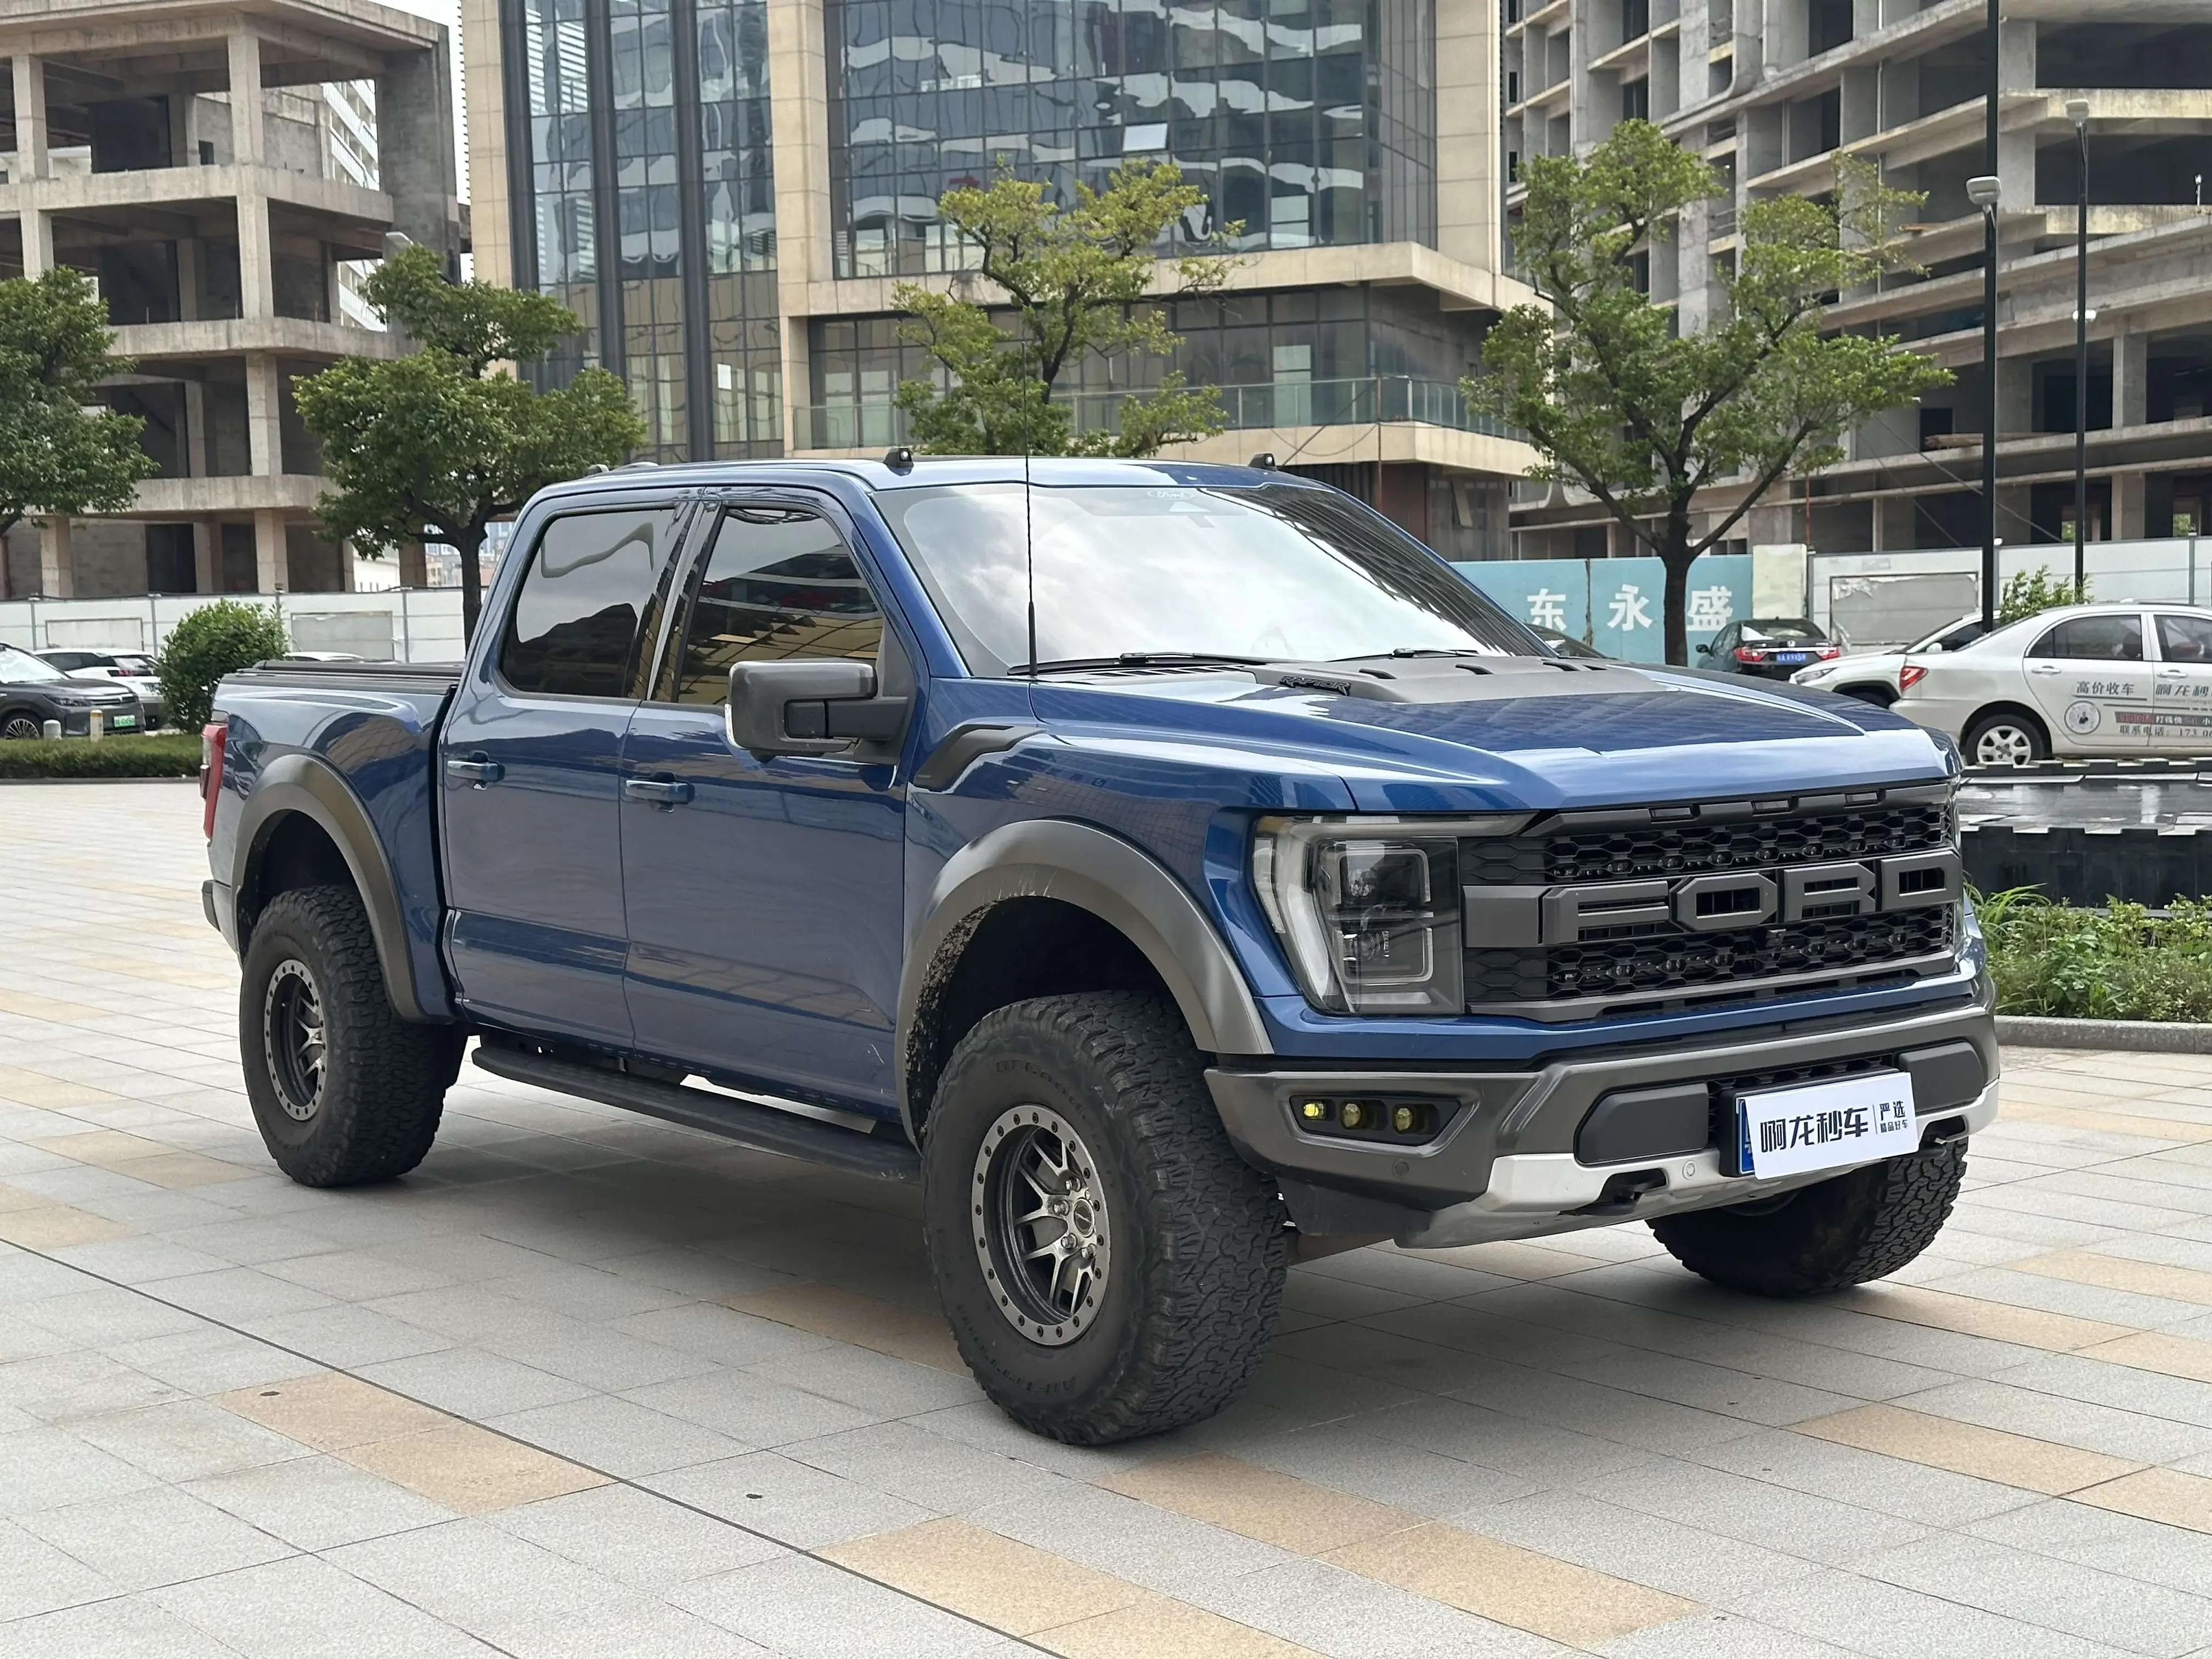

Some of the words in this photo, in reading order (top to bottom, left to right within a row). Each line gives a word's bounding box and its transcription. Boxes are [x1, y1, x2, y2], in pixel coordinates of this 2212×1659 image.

[1527, 584, 1733, 630] 东永盛
[1280, 676, 1351, 696] RAPTOR
[2076, 681, 2135, 696] 高价收车
[1543, 848, 1960, 946] FORD
[1880, 1101, 1906, 1121] 严选
[1760, 1107, 1868, 1153] 啊龙秒车
